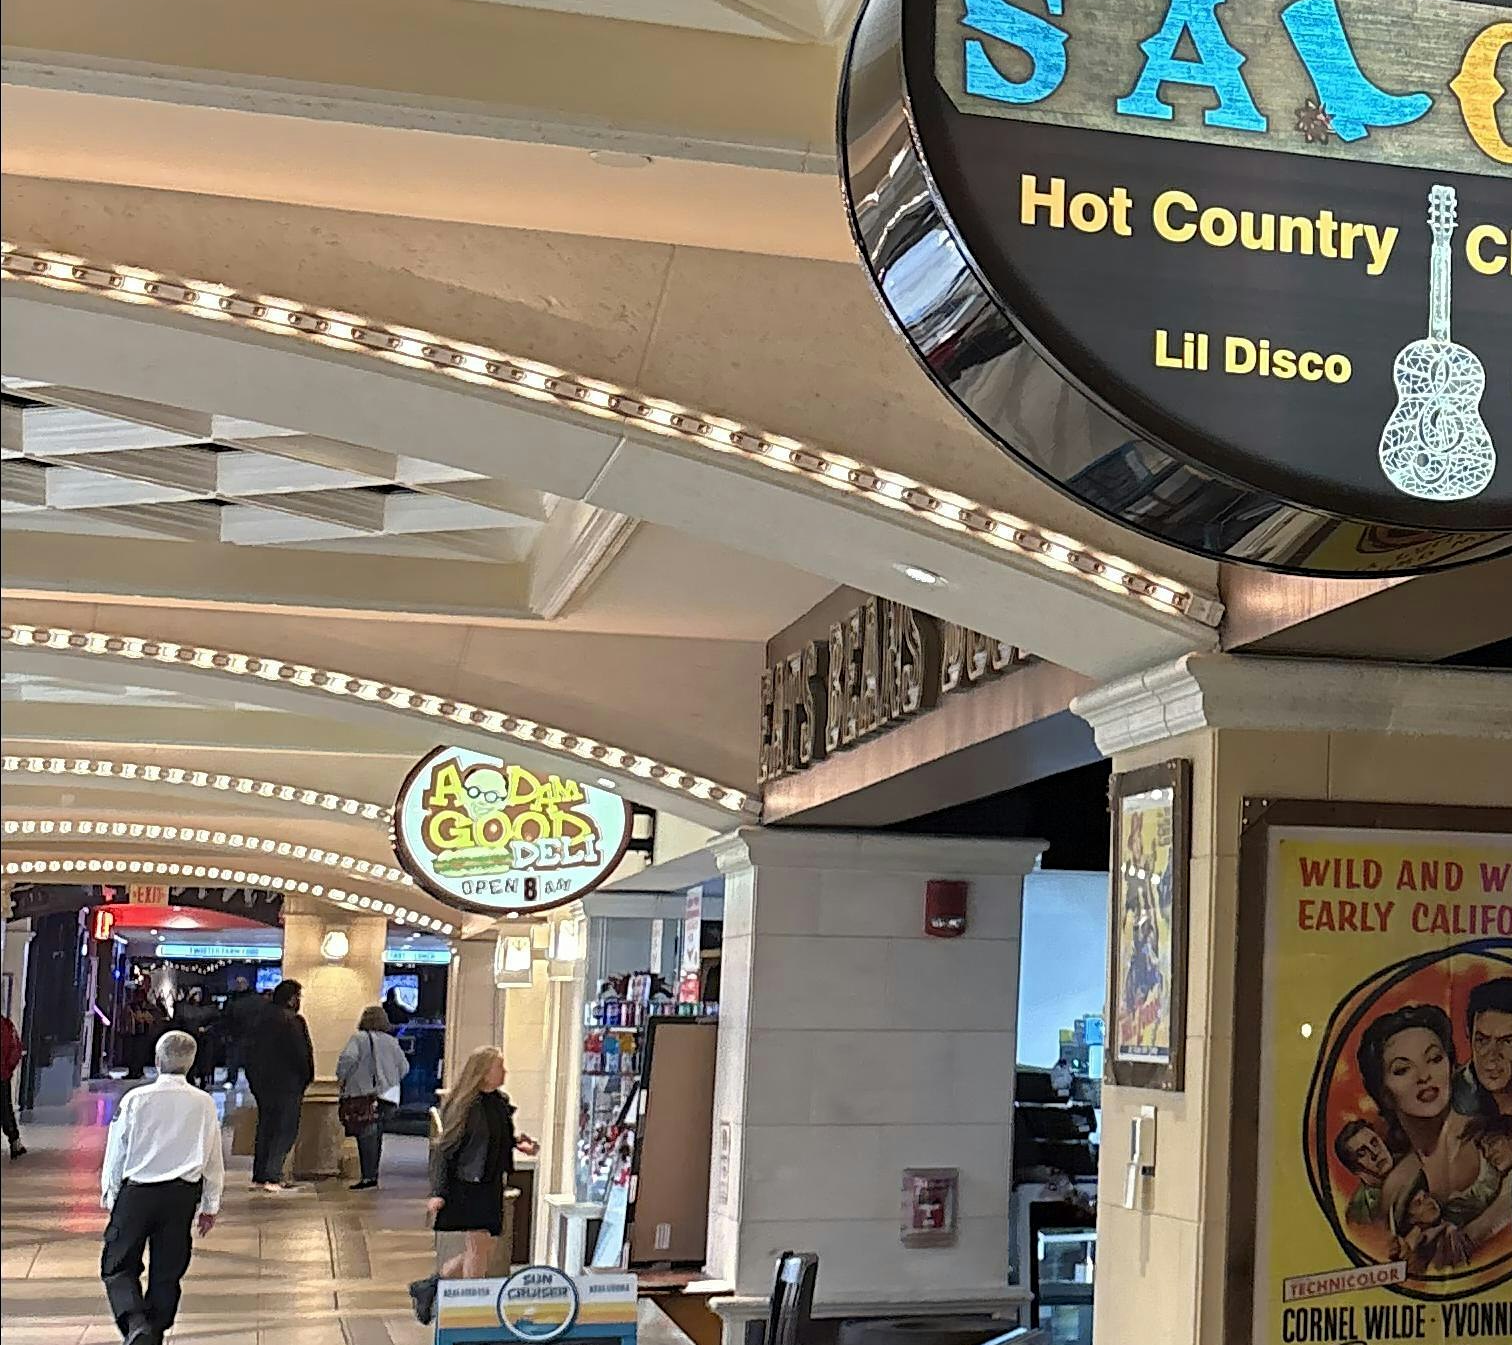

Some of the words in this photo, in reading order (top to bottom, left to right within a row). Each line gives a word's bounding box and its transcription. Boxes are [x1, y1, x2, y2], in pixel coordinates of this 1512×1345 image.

[1020, 173, 1133, 237] Hot
[1152, 189, 1400, 276] Country
[1154, 329, 1209, 371] Lil
[1224, 335, 1353, 384] Disco
[429, 809, 593, 848] GOOD
[510, 833, 600, 869] DELI
[461, 878, 519, 896] OPEN
[523, 877, 538, 901] 8
[544, 878, 572, 895] AM
[1299, 857, 1382, 890] WILD
[1396, 860, 1464, 892] AND
[1298, 899, 1396, 933] EARLY
[522, 1274, 553, 1286] SUN
[1290, 1267, 1401, 1297] TECHNICOLOR
[1282, 1306, 1358, 1344] CORNEL
[1364, 1304, 1426, 1340] WILDE
